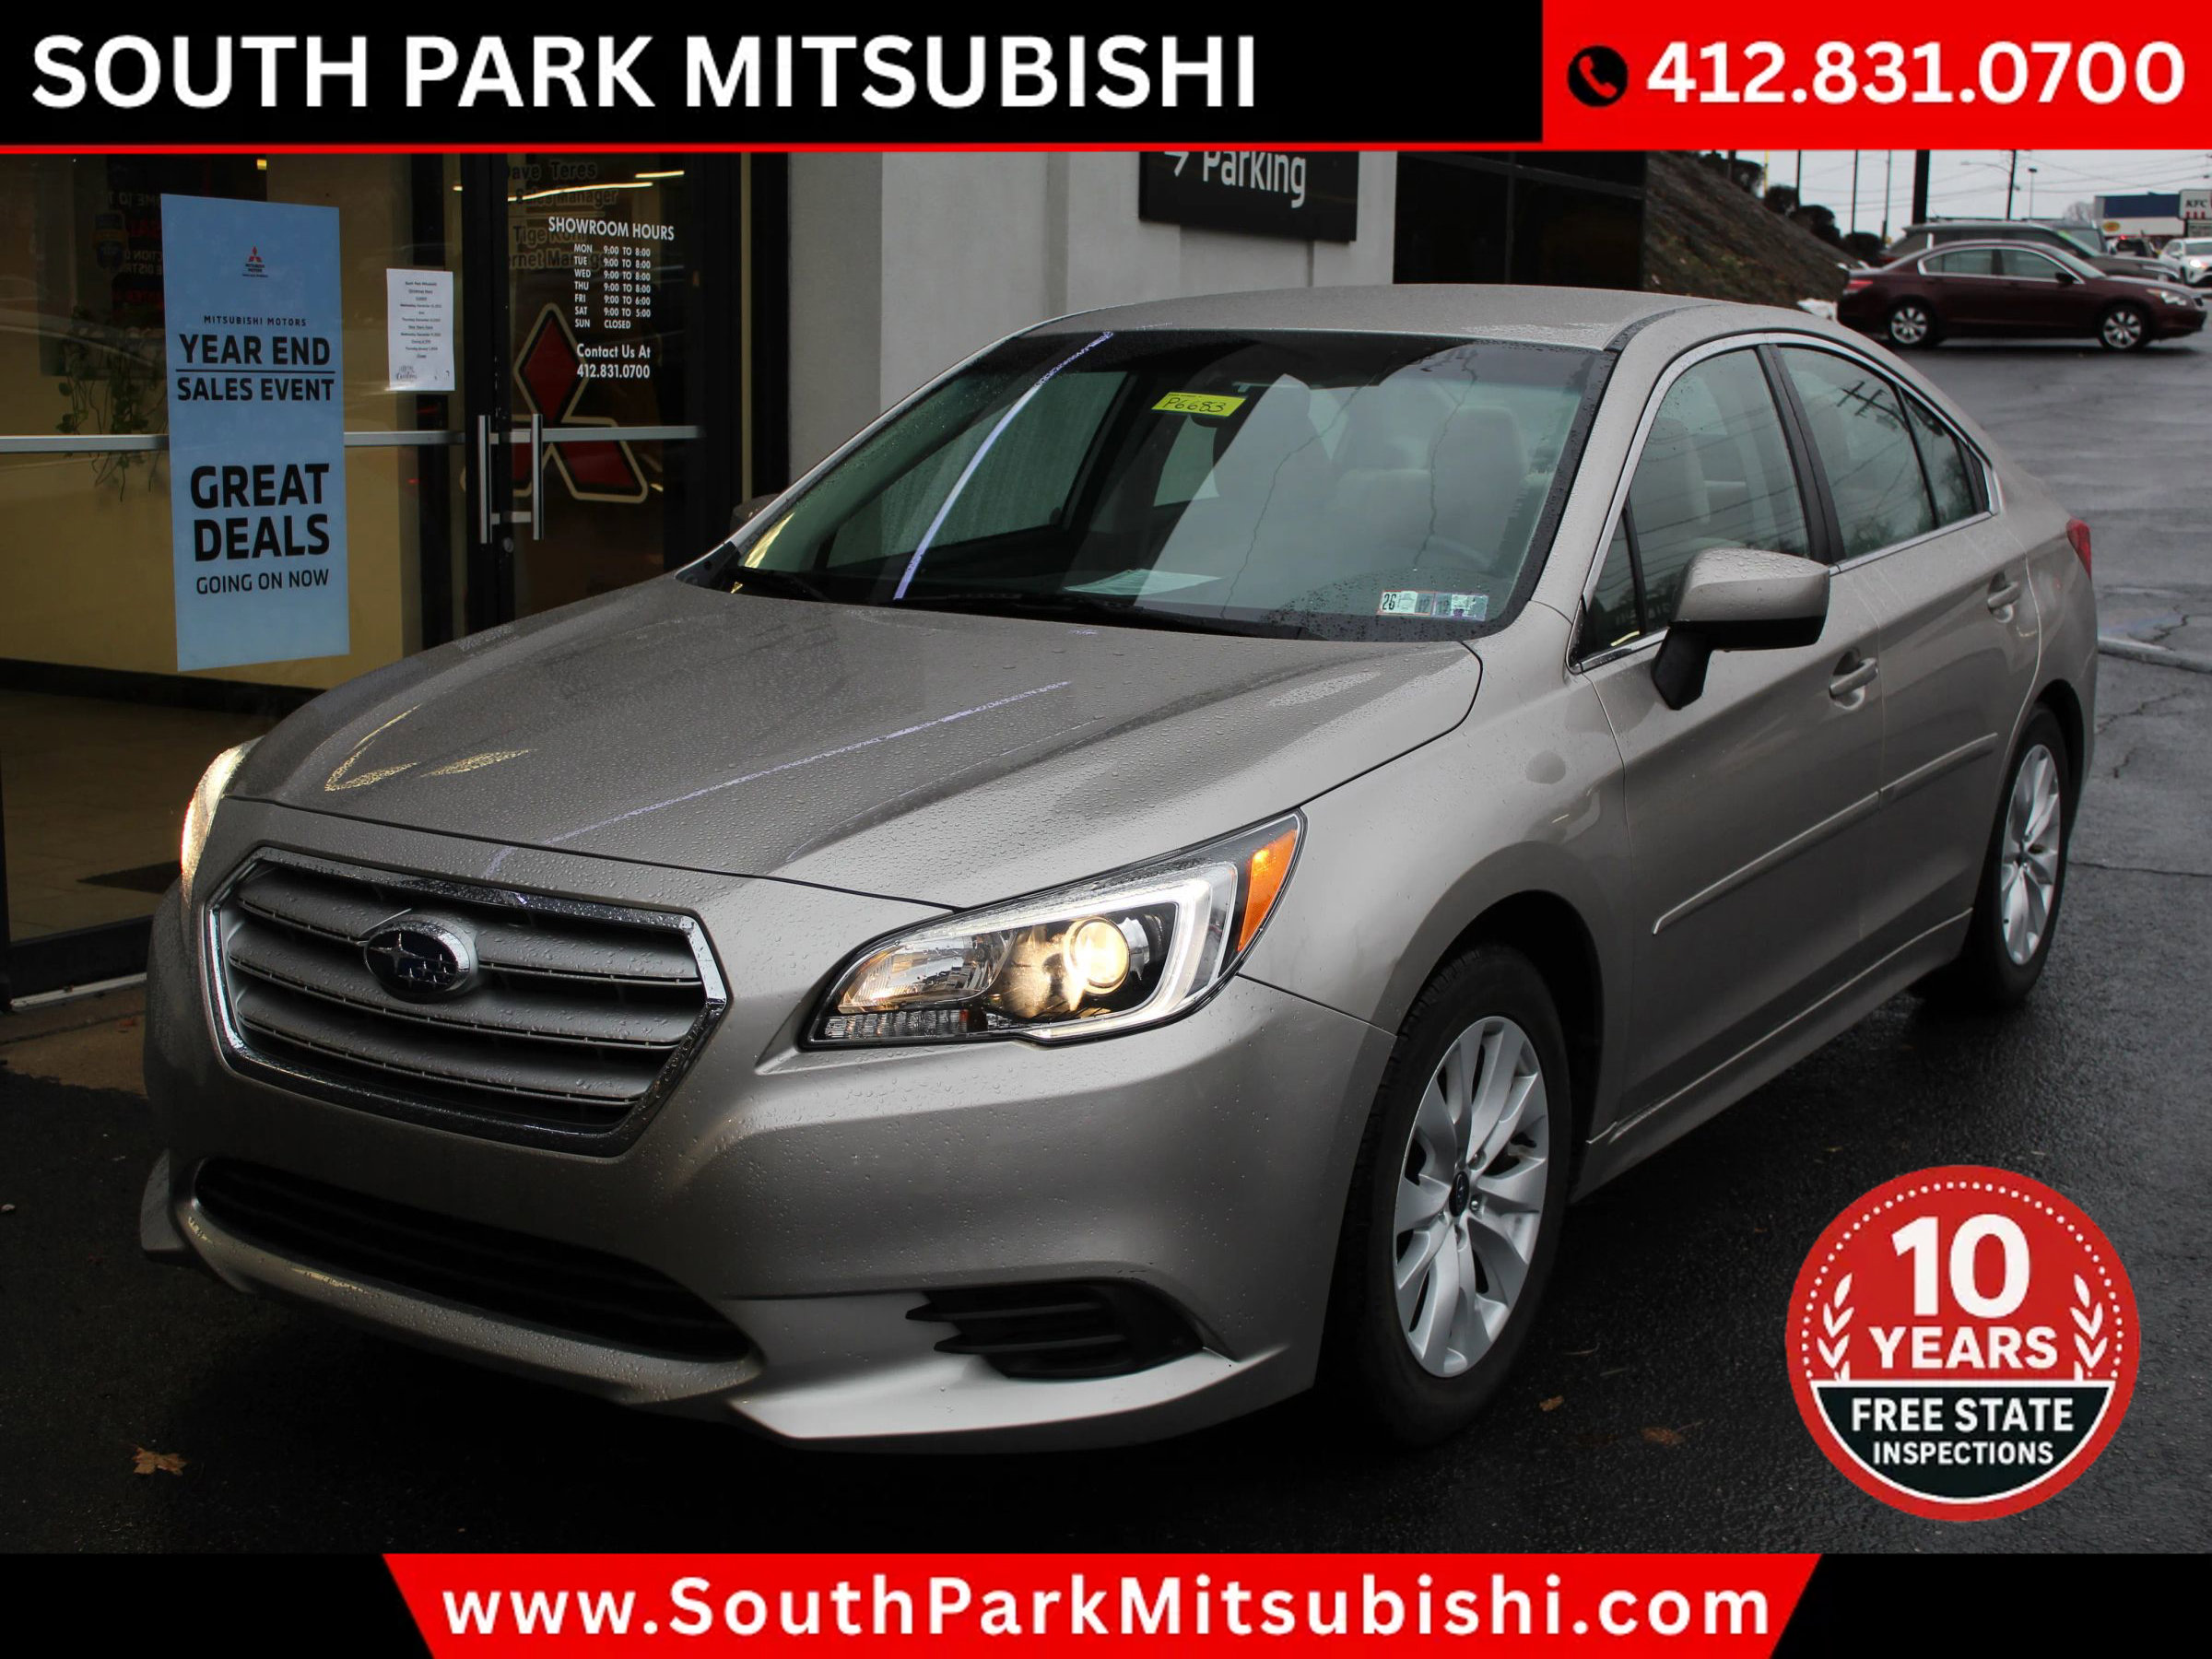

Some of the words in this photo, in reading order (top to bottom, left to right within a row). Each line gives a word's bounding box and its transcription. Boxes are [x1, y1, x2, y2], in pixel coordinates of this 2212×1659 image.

[1203, 151, 1307, 208] Parking
[2185, 198, 2208, 207] KFC
[548, 216, 629, 238] SHOWROOM
[632, 222, 676, 241] HOURS
[574, 243, 592, 253] MON
[604, 245, 619, 255] 9:00
[622, 246, 631, 255] TO
[635, 247, 651, 257] 8:00
[574, 256, 587, 265] TUE
[604, 258, 618, 267] 9:00
[622, 259, 631, 268] TO
[635, 260, 651, 269] 8:00
[574, 268, 591, 277] WED
[604, 270, 619, 279] 9:00
[622, 271, 632, 280] TO
[635, 272, 651, 281] 8:00
[574, 281, 589, 290] THU
[604, 282, 619, 292] 9:00
[622, 283, 632, 292] TO
[635, 284, 651, 293] 8:00
[574, 294, 586, 303] FRI
[604, 295, 619, 304] 9:00
[622, 296, 632, 305] TO
[635, 297, 651, 306] 6:00
[574, 306, 588, 315] SAT
[604, 308, 619, 317] 9:00
[621, 308, 631, 317] TO
[635, 309, 651, 318] 5:00
[204, 315, 263, 325] MITSUBISHI
[266, 317, 307, 327] MOTORS
[574, 319, 591, 328] SUN
[604, 320, 631, 329] CLOSED
[179, 334, 263, 365] YEAR
[272, 335, 331, 366] END
[576, 343, 618, 359] Contact
[621, 344, 635, 359] Us
[638, 345, 651, 359] At
[576, 364, 651, 379] 412.831.0700
[177, 376, 253, 401] SALES
[261, 378, 335, 402] EVENT
[190, 463, 330, 509] GREAT
[194, 513, 330, 562] DEALS
[196, 573, 253, 594] GOING
[258, 571, 282, 591] ON
[288, 569, 330, 588] NOW
[1382, 593, 1396, 610] 26
